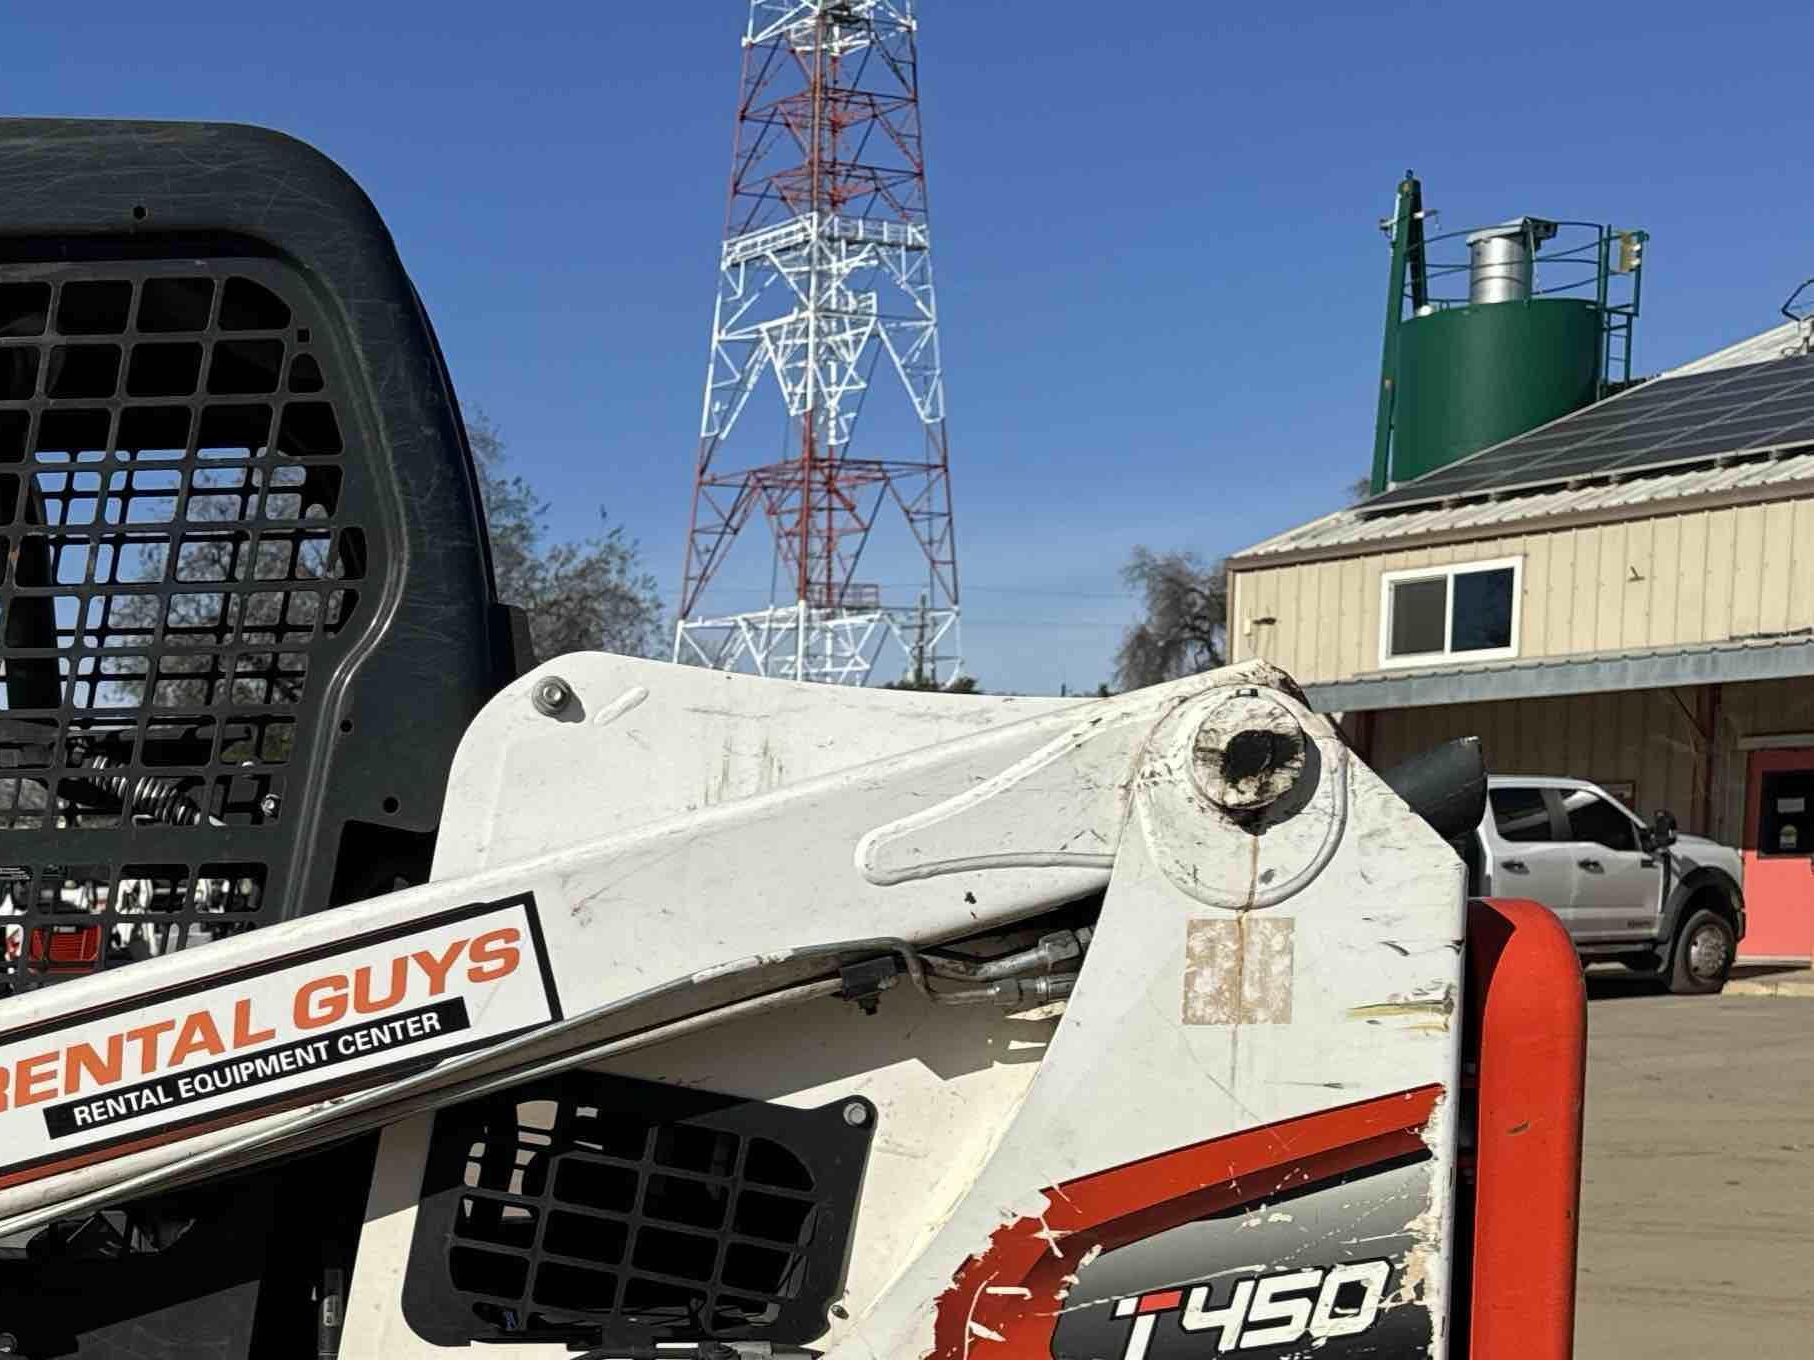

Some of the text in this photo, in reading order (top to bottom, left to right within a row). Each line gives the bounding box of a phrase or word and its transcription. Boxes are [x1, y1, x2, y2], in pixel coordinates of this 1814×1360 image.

[293, 927, 520, 1030] GUYS
[73, 1012, 442, 1126] RENTAL EQUIPMENT CENTER
